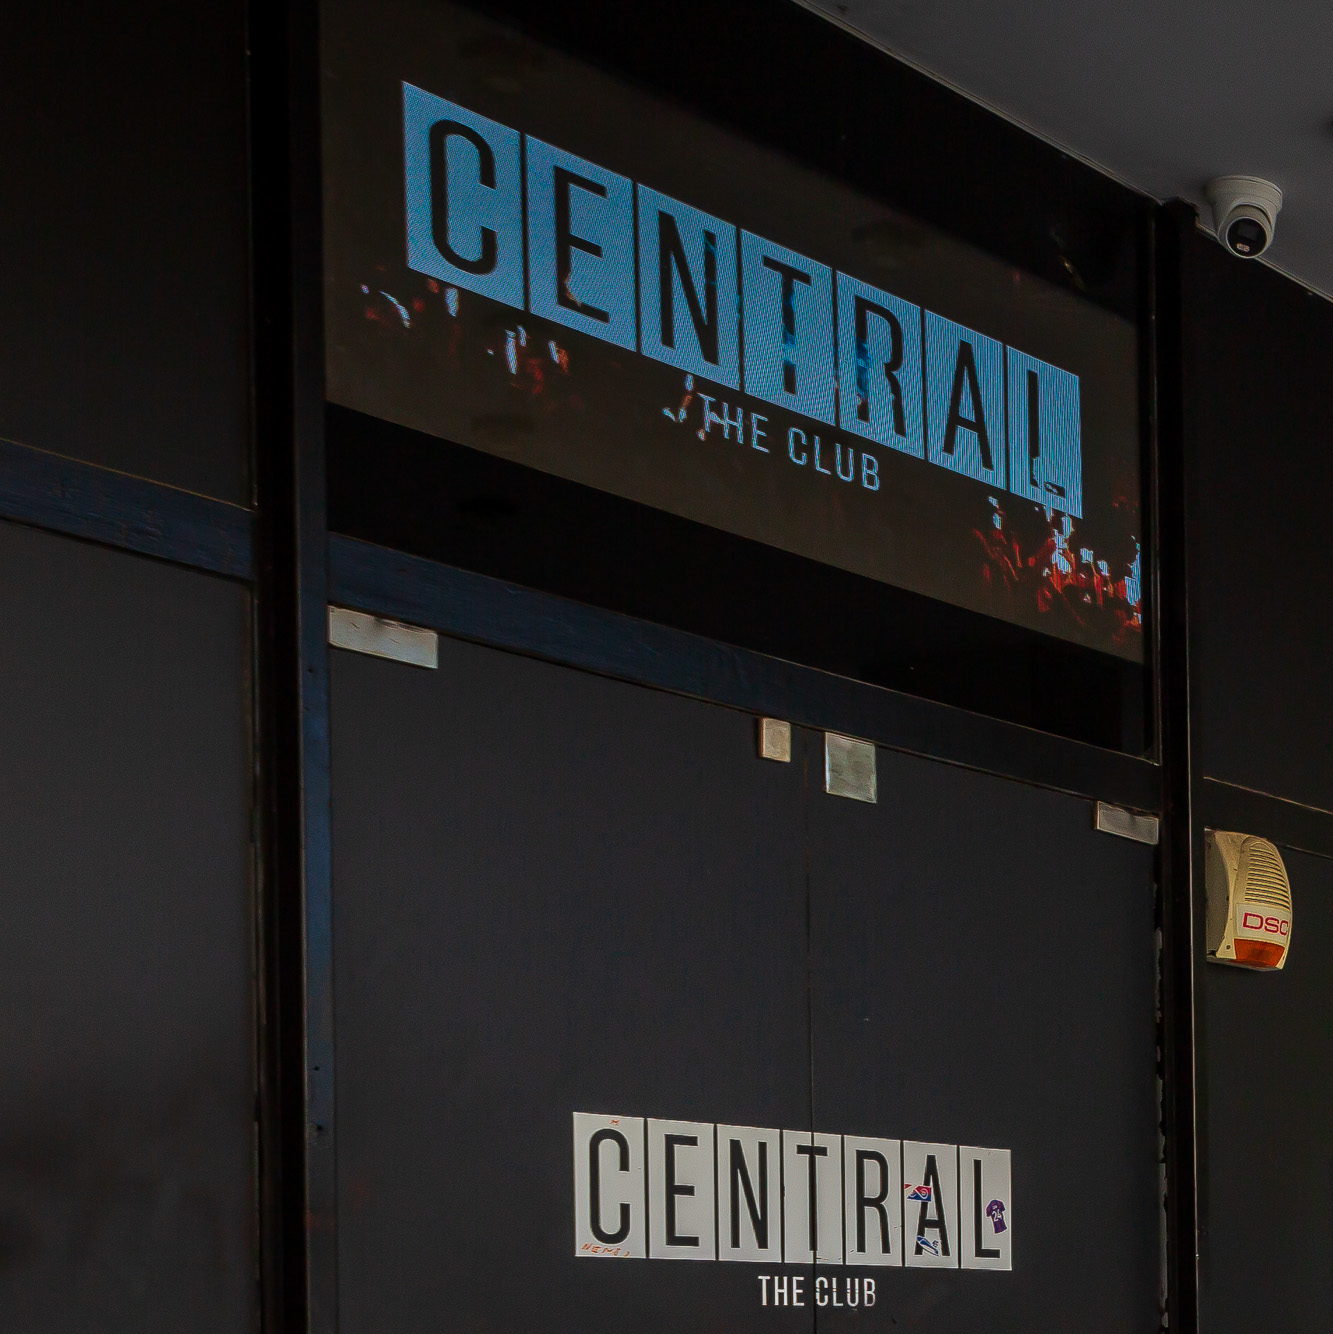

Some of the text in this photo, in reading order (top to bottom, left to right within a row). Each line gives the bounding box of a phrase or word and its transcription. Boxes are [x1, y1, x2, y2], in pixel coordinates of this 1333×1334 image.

[426, 116, 1069, 501] CENTRAL
[697, 391, 882, 493] THE CLUB
[1242, 912, 1290, 936] DSC
[588, 1128, 1003, 1260] CENTRAL
[757, 1275, 877, 1307] THE CLUB
